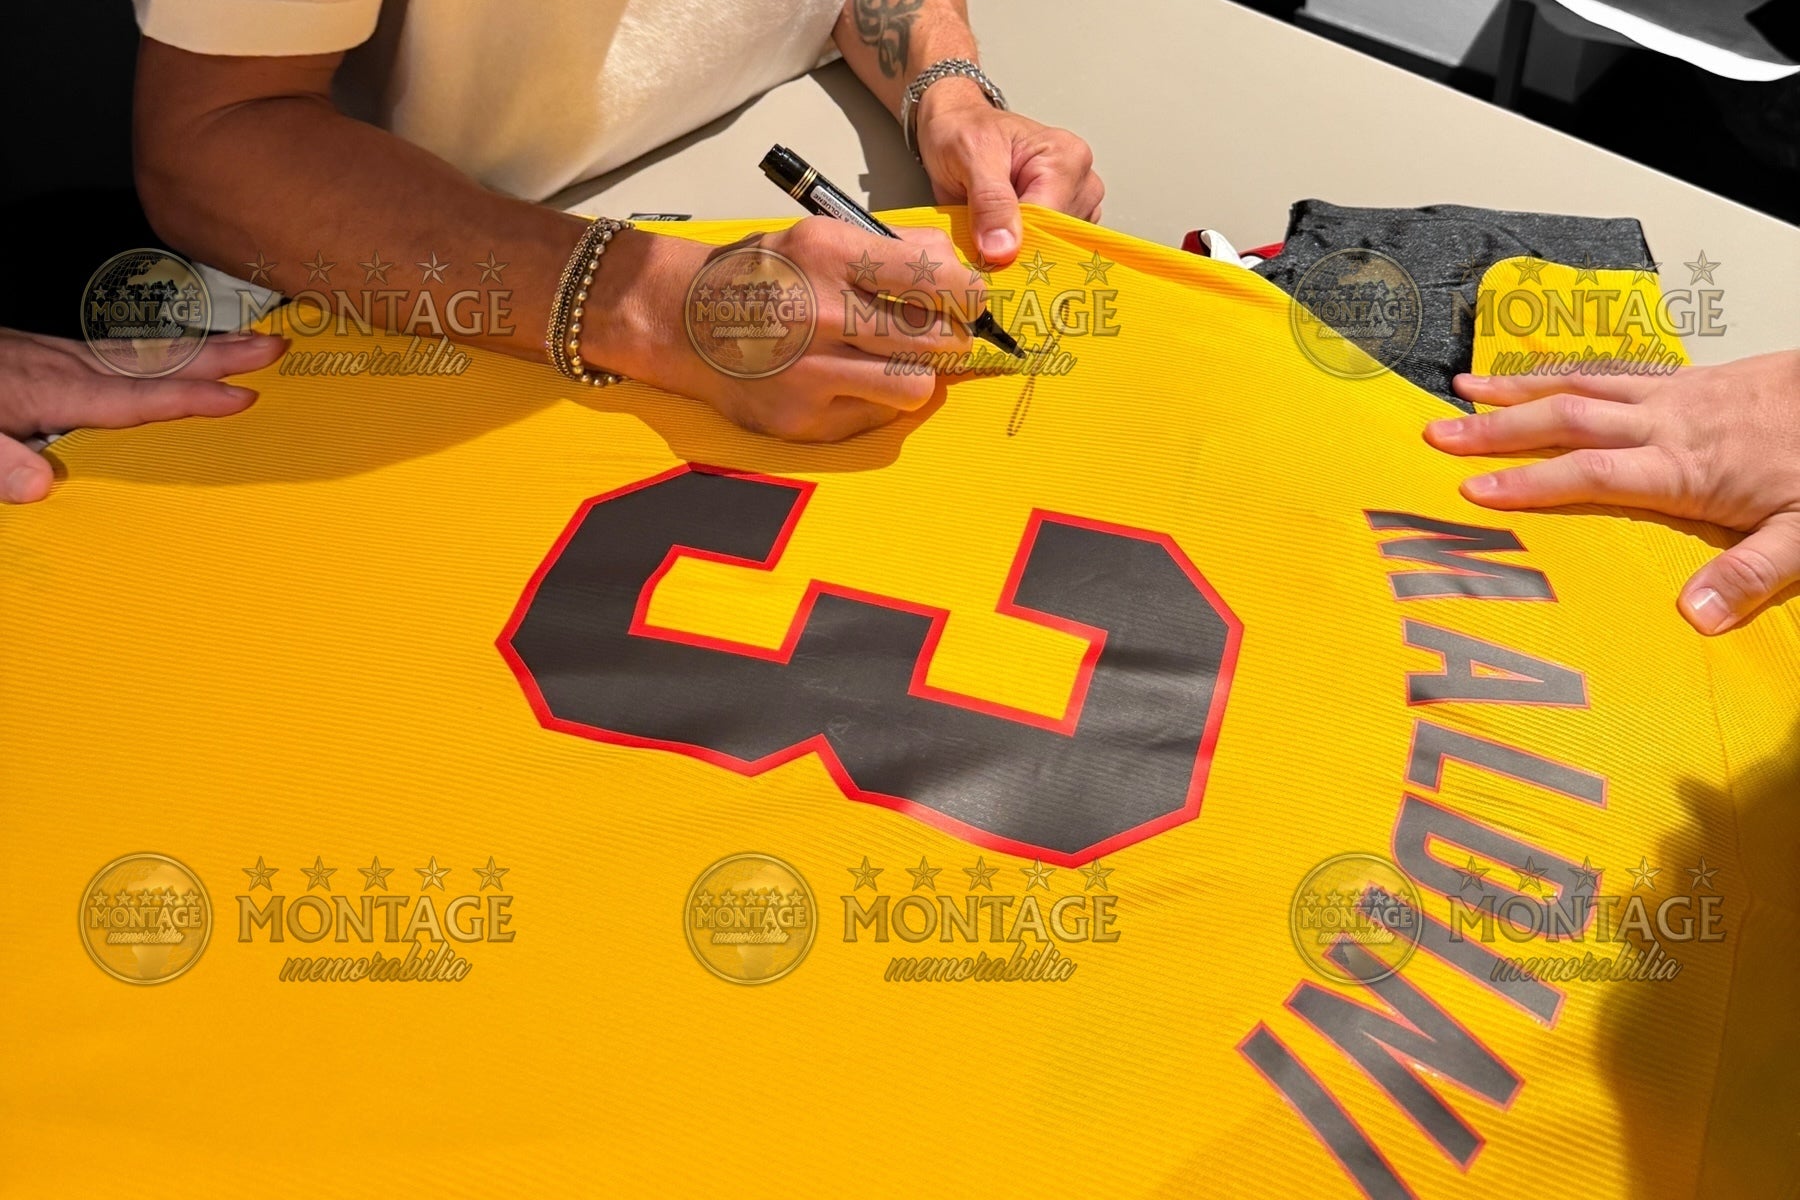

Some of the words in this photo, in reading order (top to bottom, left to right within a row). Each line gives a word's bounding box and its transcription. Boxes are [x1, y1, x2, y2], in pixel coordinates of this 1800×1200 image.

[811, 192, 844, 219] TOLUENE
[494, 461, 1245, 870] 3
[1236, 508, 1610, 1200] MALDINI
